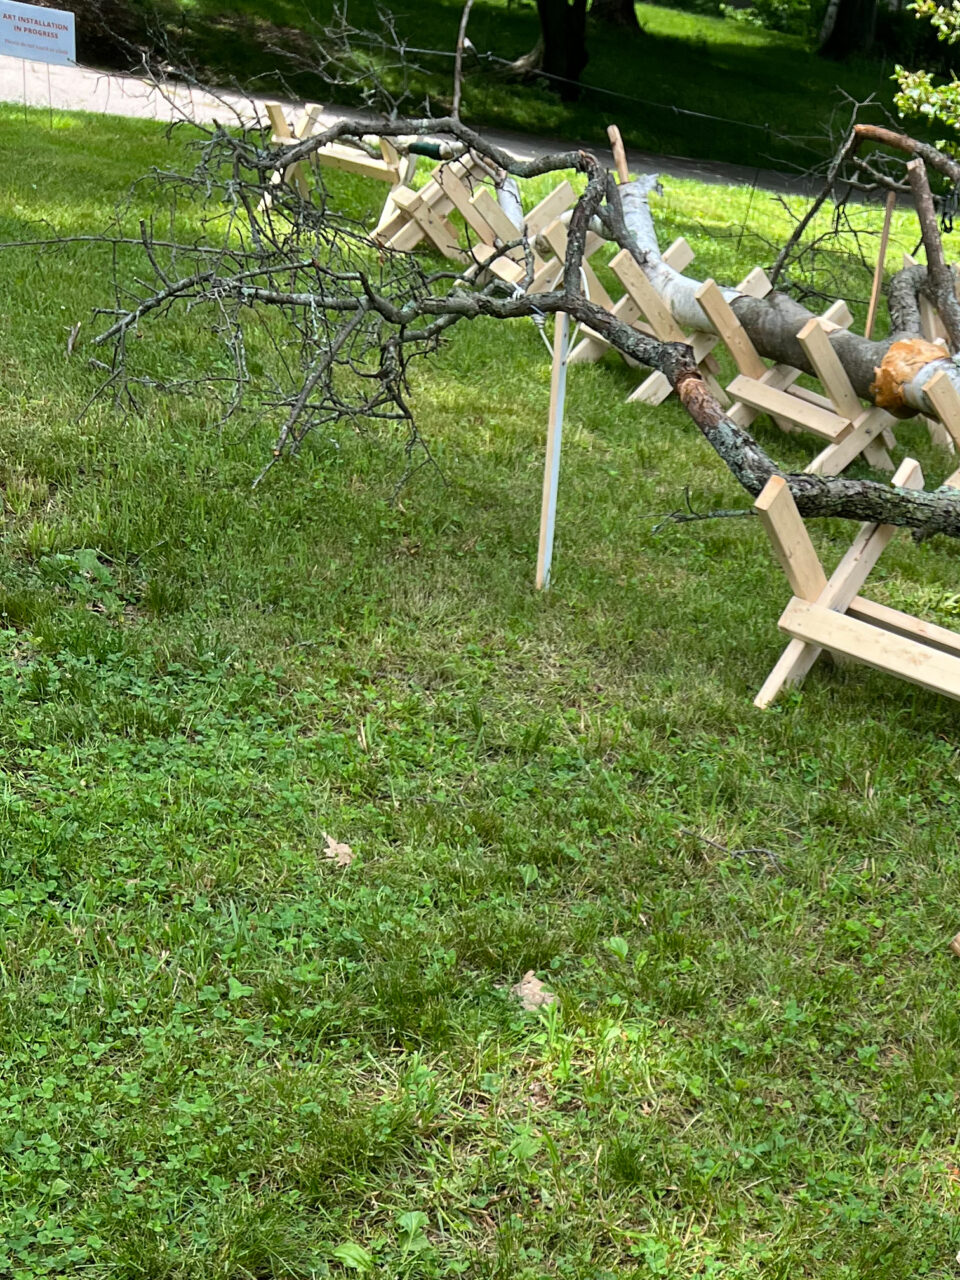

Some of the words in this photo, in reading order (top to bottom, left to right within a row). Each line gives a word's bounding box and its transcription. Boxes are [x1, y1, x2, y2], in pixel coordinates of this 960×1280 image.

[3, 13, 16, 21] ART
[18, 16, 69, 31] INSTALLATION
[24, 27, 59, 39] PROGRESS
